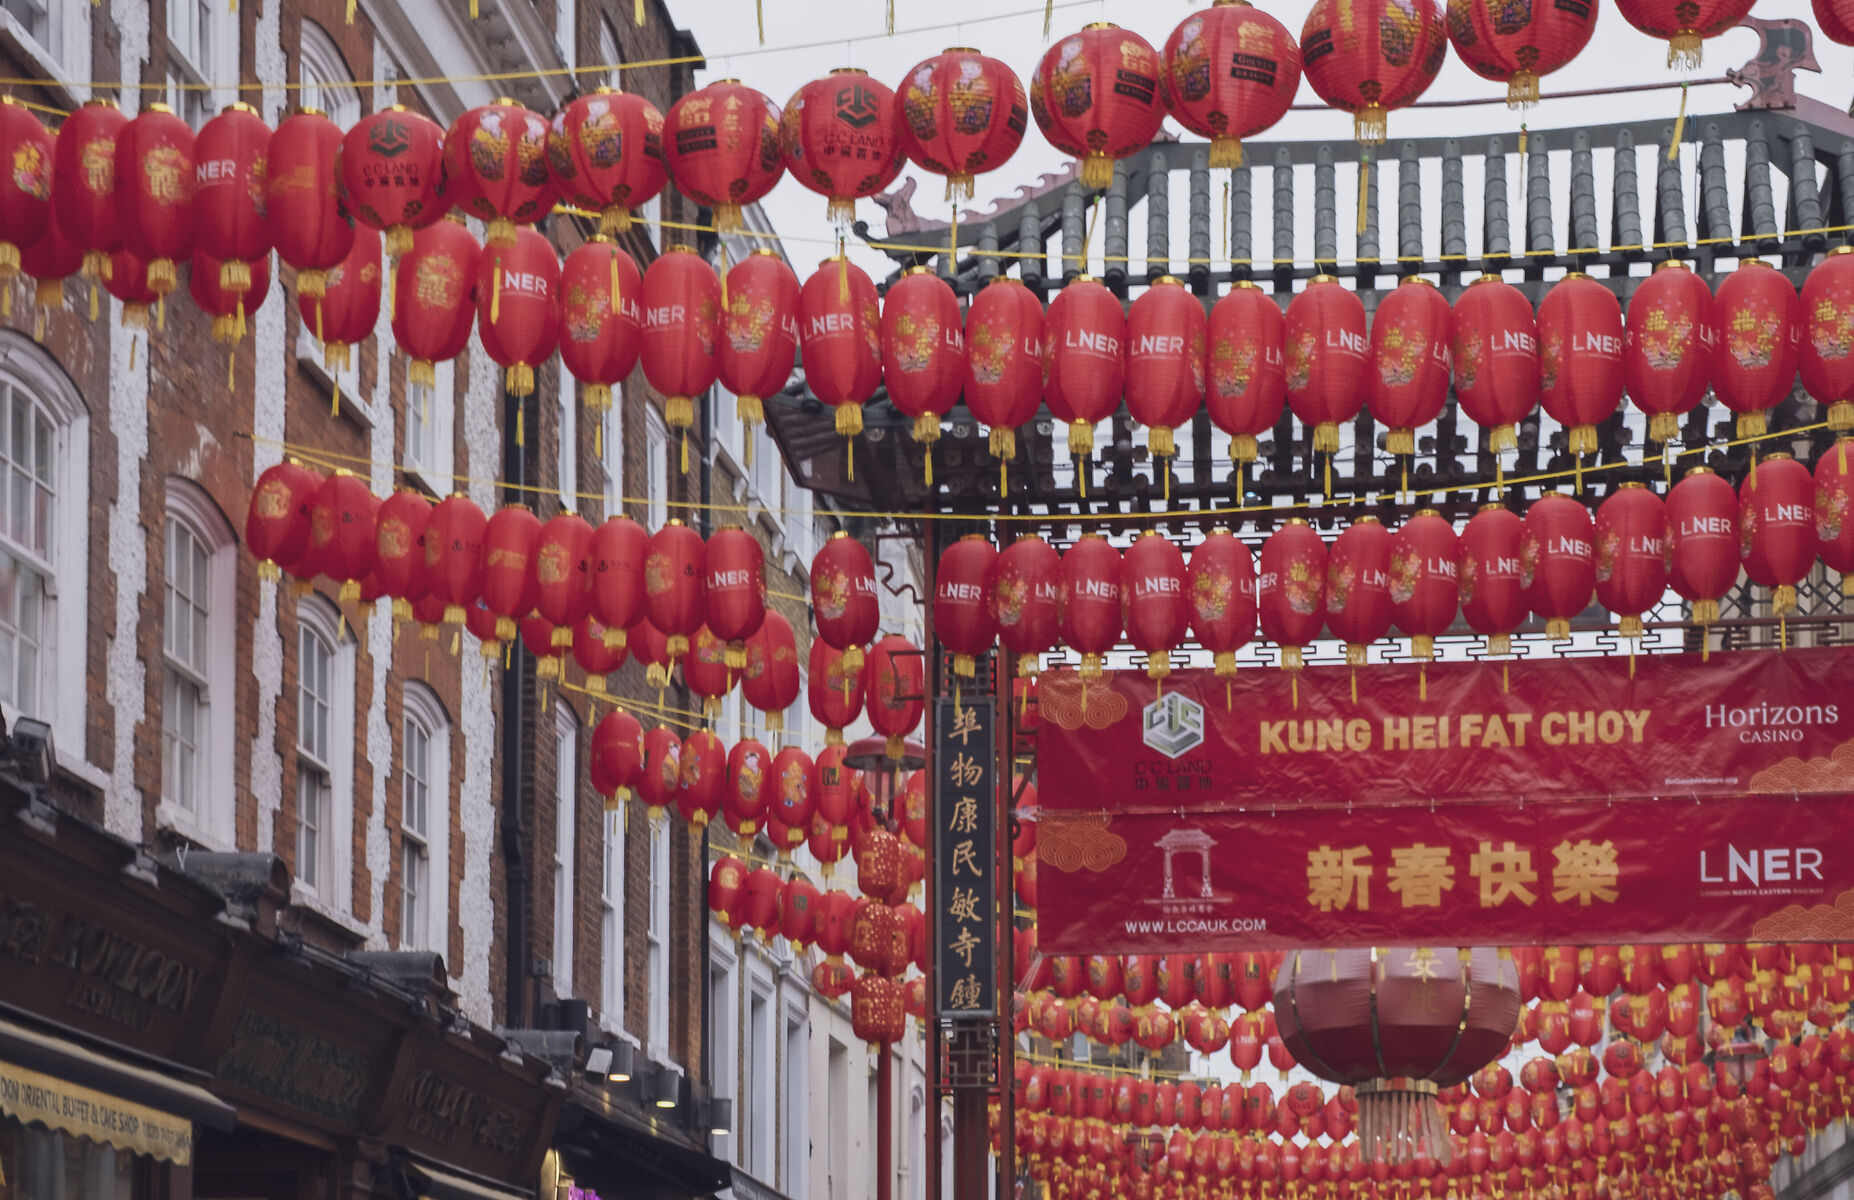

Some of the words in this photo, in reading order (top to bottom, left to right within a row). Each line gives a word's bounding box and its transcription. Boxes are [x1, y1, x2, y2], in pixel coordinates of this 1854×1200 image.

[197, 158, 237, 183] NER
[502, 270, 548, 297] NER
[620, 297, 640, 319] LN
[945, 327, 964, 351] LN
[1024, 336, 1043, 358] LN
[1066, 327, 1120, 357] LNER
[1131, 333, 1185, 356] LNER
[1572, 330, 1623, 354] LNER
[1681, 515, 1731, 536] LNER
[1548, 534, 1592, 557] LNER
[1630, 534, 1663, 556] LNE
[1427, 556, 1457, 580] LNE
[1486, 556, 1520, 577] LNE
[707, 569, 750, 590] LNER
[939, 580, 982, 602] LNER
[1135, 574, 1181, 596] LNER
[1704, 701, 1839, 729] Horizons
[1259, 718, 1372, 755] KUNG
[1383, 714, 1449, 751] HEI
[1460, 712, 1533, 748] FAT
[1541, 708, 1651, 746] CHOY
[1739, 728, 1804, 744] CASINO
[1306, 838, 1620, 912] 新春快樂
[1699, 843, 1824, 888] LNER
[1732, 888, 1758, 896] NORTH
[1759, 888, 1792, 896] EASTERN
[1125, 918, 1266, 934] WWW.LCCAUK.COM
[62, 1095, 90, 1122] BUFFET
[119, 1111, 139, 1136] SHOP
